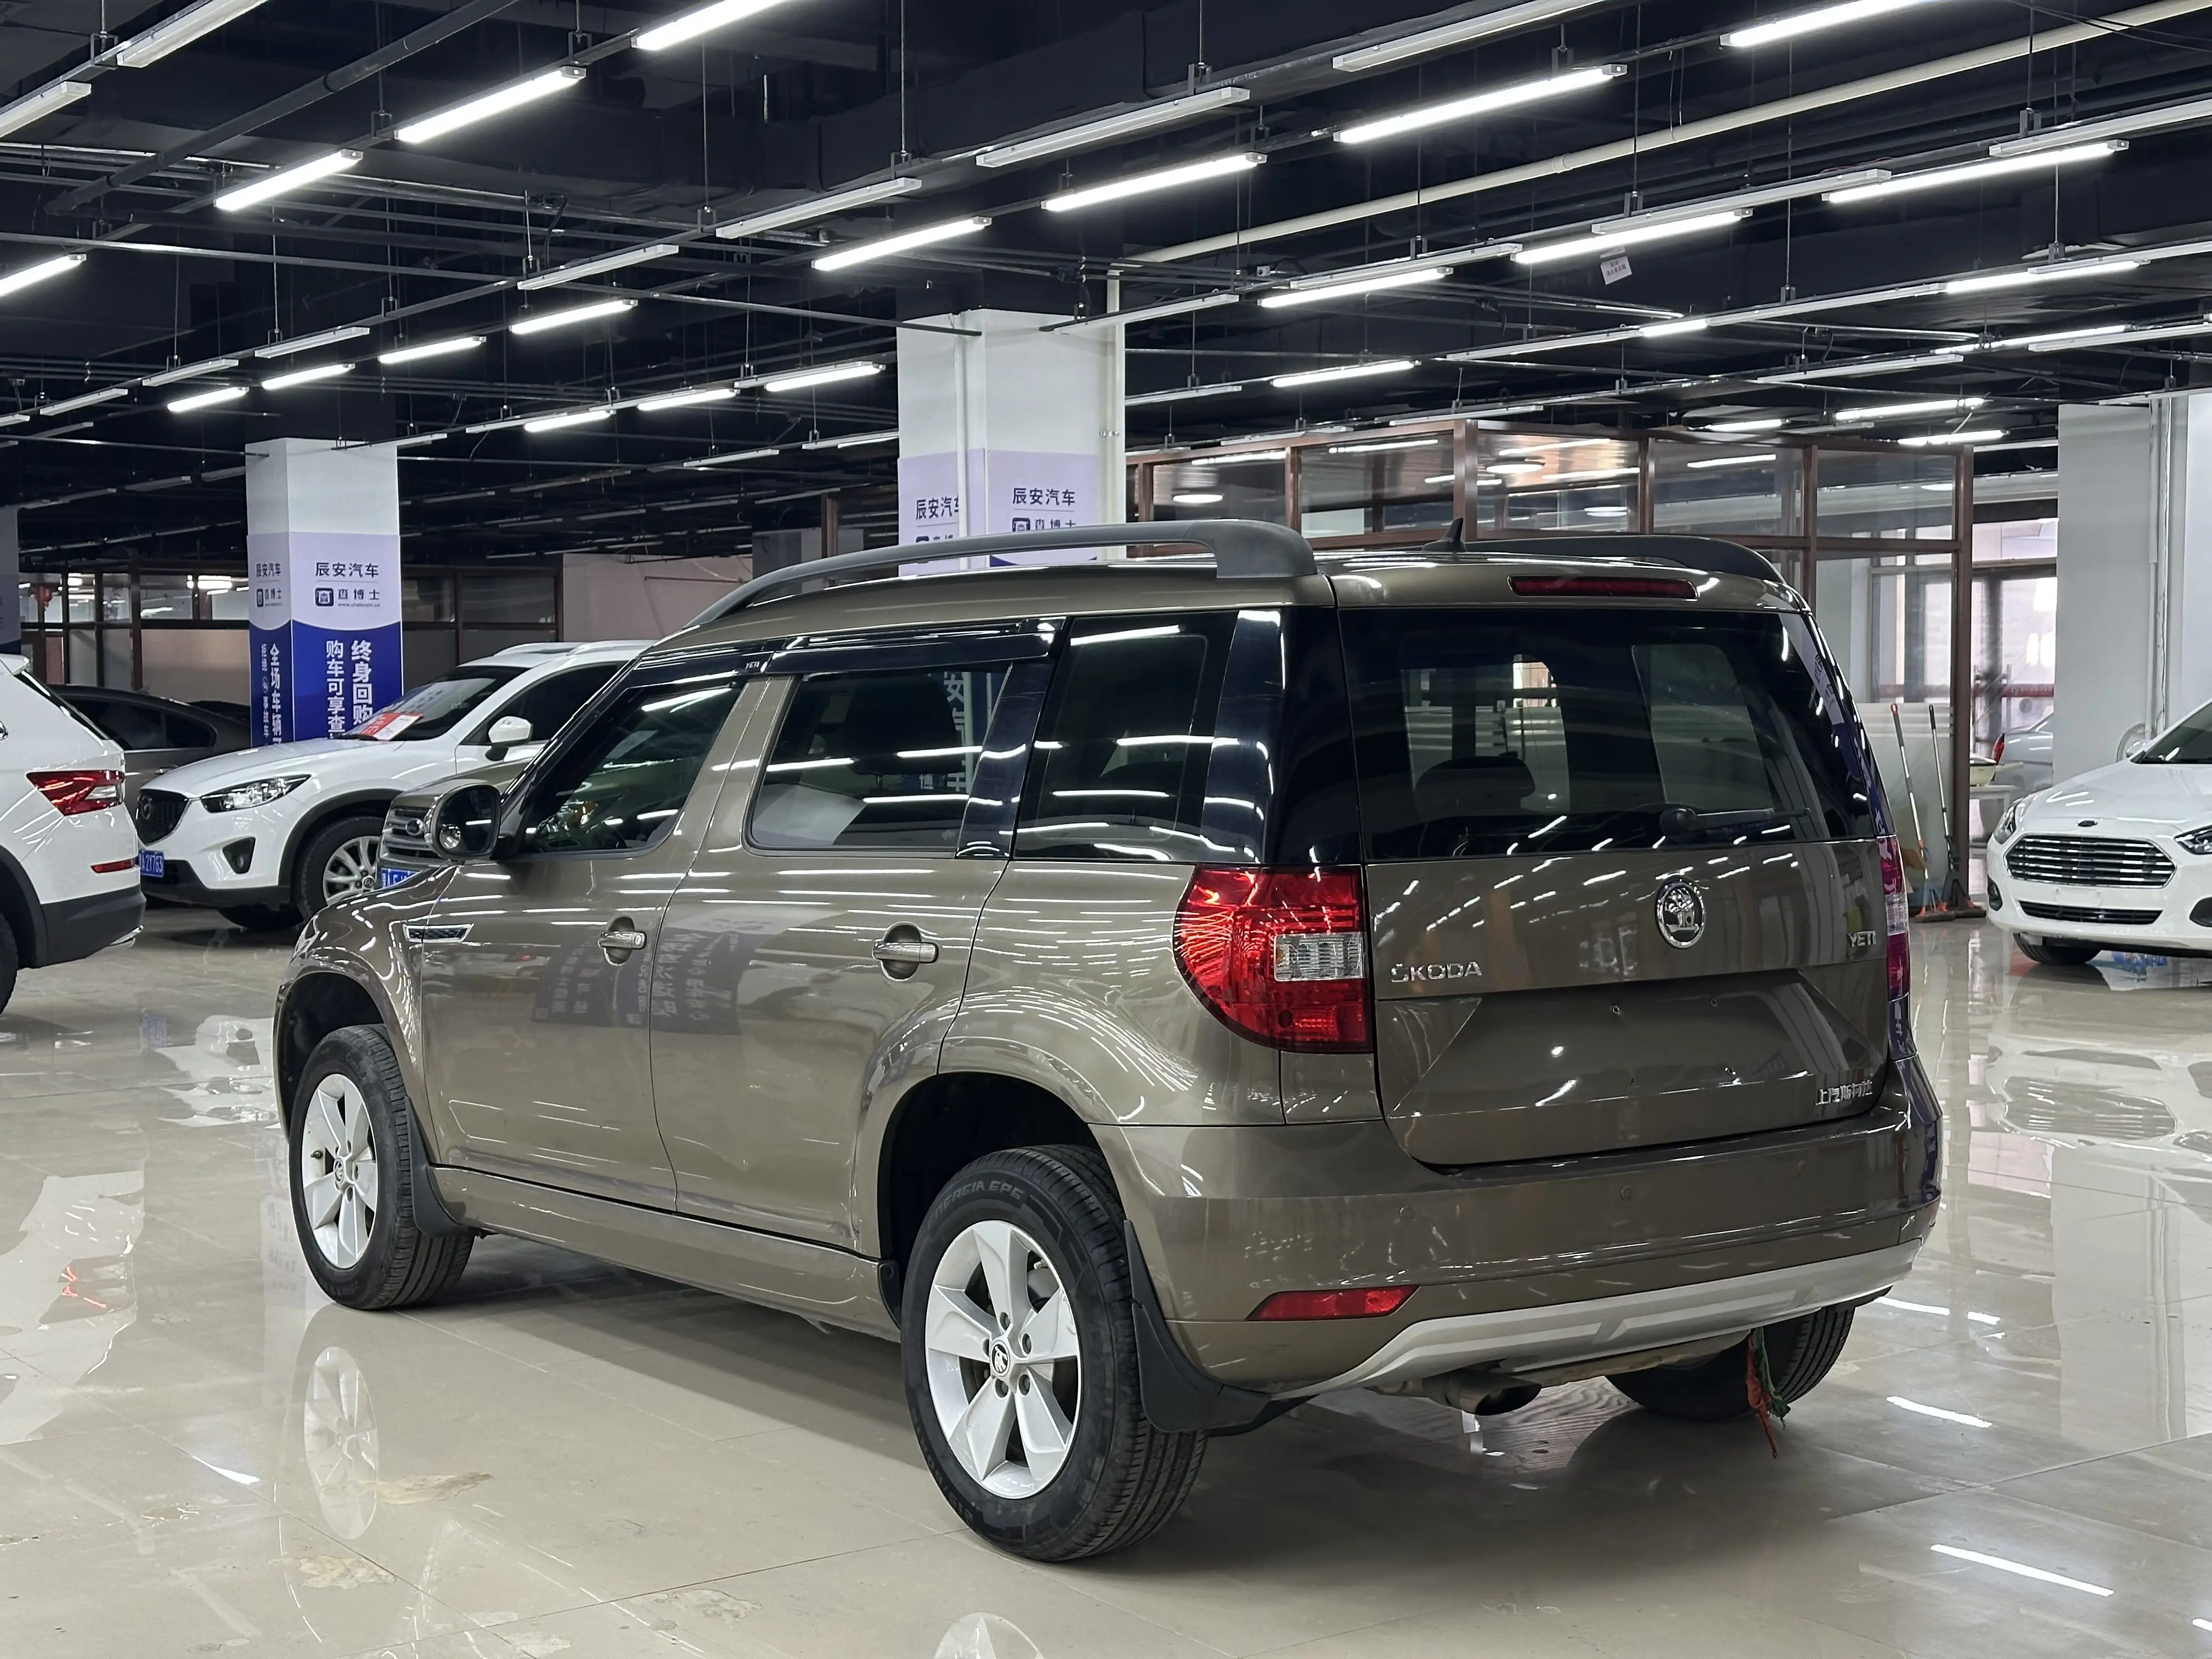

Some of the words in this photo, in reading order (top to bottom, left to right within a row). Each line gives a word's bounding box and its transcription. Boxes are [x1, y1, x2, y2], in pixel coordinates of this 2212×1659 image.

[1013, 488, 1075, 506] 辰安汽车
[256, 562, 281, 578] 辰安汽车
[315, 562, 379, 578] 辰安汽车
[337, 588, 380, 601] 查博士
[746, 661, 760, 669] YETI
[351, 640, 373, 725] 终身回购
[1848, 930, 1876, 947] YETI
